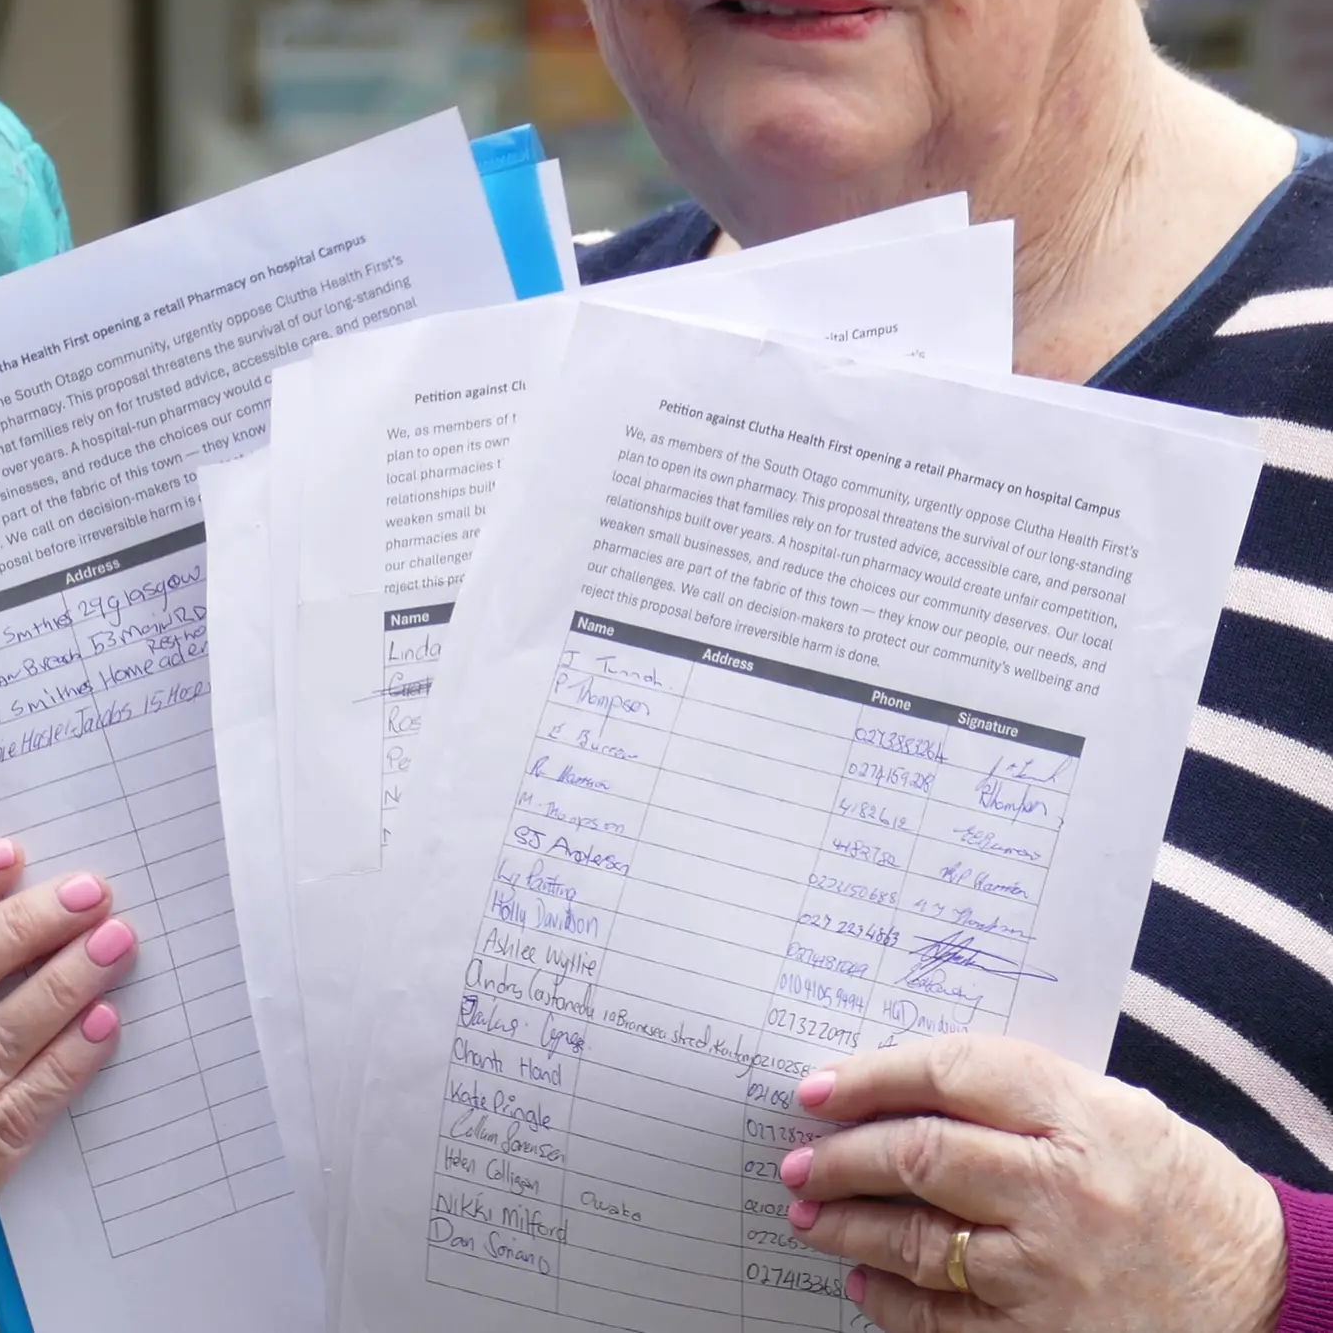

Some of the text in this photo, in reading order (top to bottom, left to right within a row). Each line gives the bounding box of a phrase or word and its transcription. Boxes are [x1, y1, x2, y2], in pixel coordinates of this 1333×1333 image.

[19, 341, 62, 365] Health
[61, 331, 90, 351] First
[91, 314, 142, 340] opening
[142, 311, 151, 322] a
[152, 296, 186, 318] retail
[185, 276, 246, 306] Pharmacy
[248, 270, 266, 284] on
[265, 249, 316, 277] hospital
[316, 234, 367, 259] Campus
[13, 378, 53, 402] South
[53, 365, 94, 387] Otago
[95, 338, 171, 373] community,
[171, 319, 223, 346] urgently
[225, 301, 273, 327] oppose
[274, 285, 318, 309] Clutha
[318, 268, 363, 292] Health
[363, 254, 404, 276] First's
[64, 388, 94, 407] This
[94, 366, 151, 400] proposal
[150, 347, 213, 377] threatens
[212, 339, 236, 355] the
[236, 318, 286, 347] survival
[286, 312, 300, 329] of
[301, 306, 323, 324] our
[323, 275, 412, 315] long-standing
[851, 323, 899, 341] Campus
[413, 382, 508, 405] Petition against
[385, 412, 508, 440] We, as members of
[385, 436, 510, 465] plan to open its own
[658, 398, 1121, 519] Petition against Clutha Health First opening a retail Pharmacy on hospital Campus
[610, 469, 1127, 605] local pharmacies that families rely on for trusted advice, accessible care, and personal
[65, 559, 120, 585] Address
[604, 493, 1118, 629] relationships built over years. A hospital-run pharmacy would create unfair competition,
[391, 612, 430, 627] Name
[579, 583, 880, 668] reject this proposal before irreversible harm is done.
[388, 634, 442, 661] Linda
[577, 616, 1019, 738] Name Address Phone Signature
[483, 927, 536, 962] Ashlee
[450, 1079, 489, 1110] Kate
[429, 1217, 474, 1252] Dan
